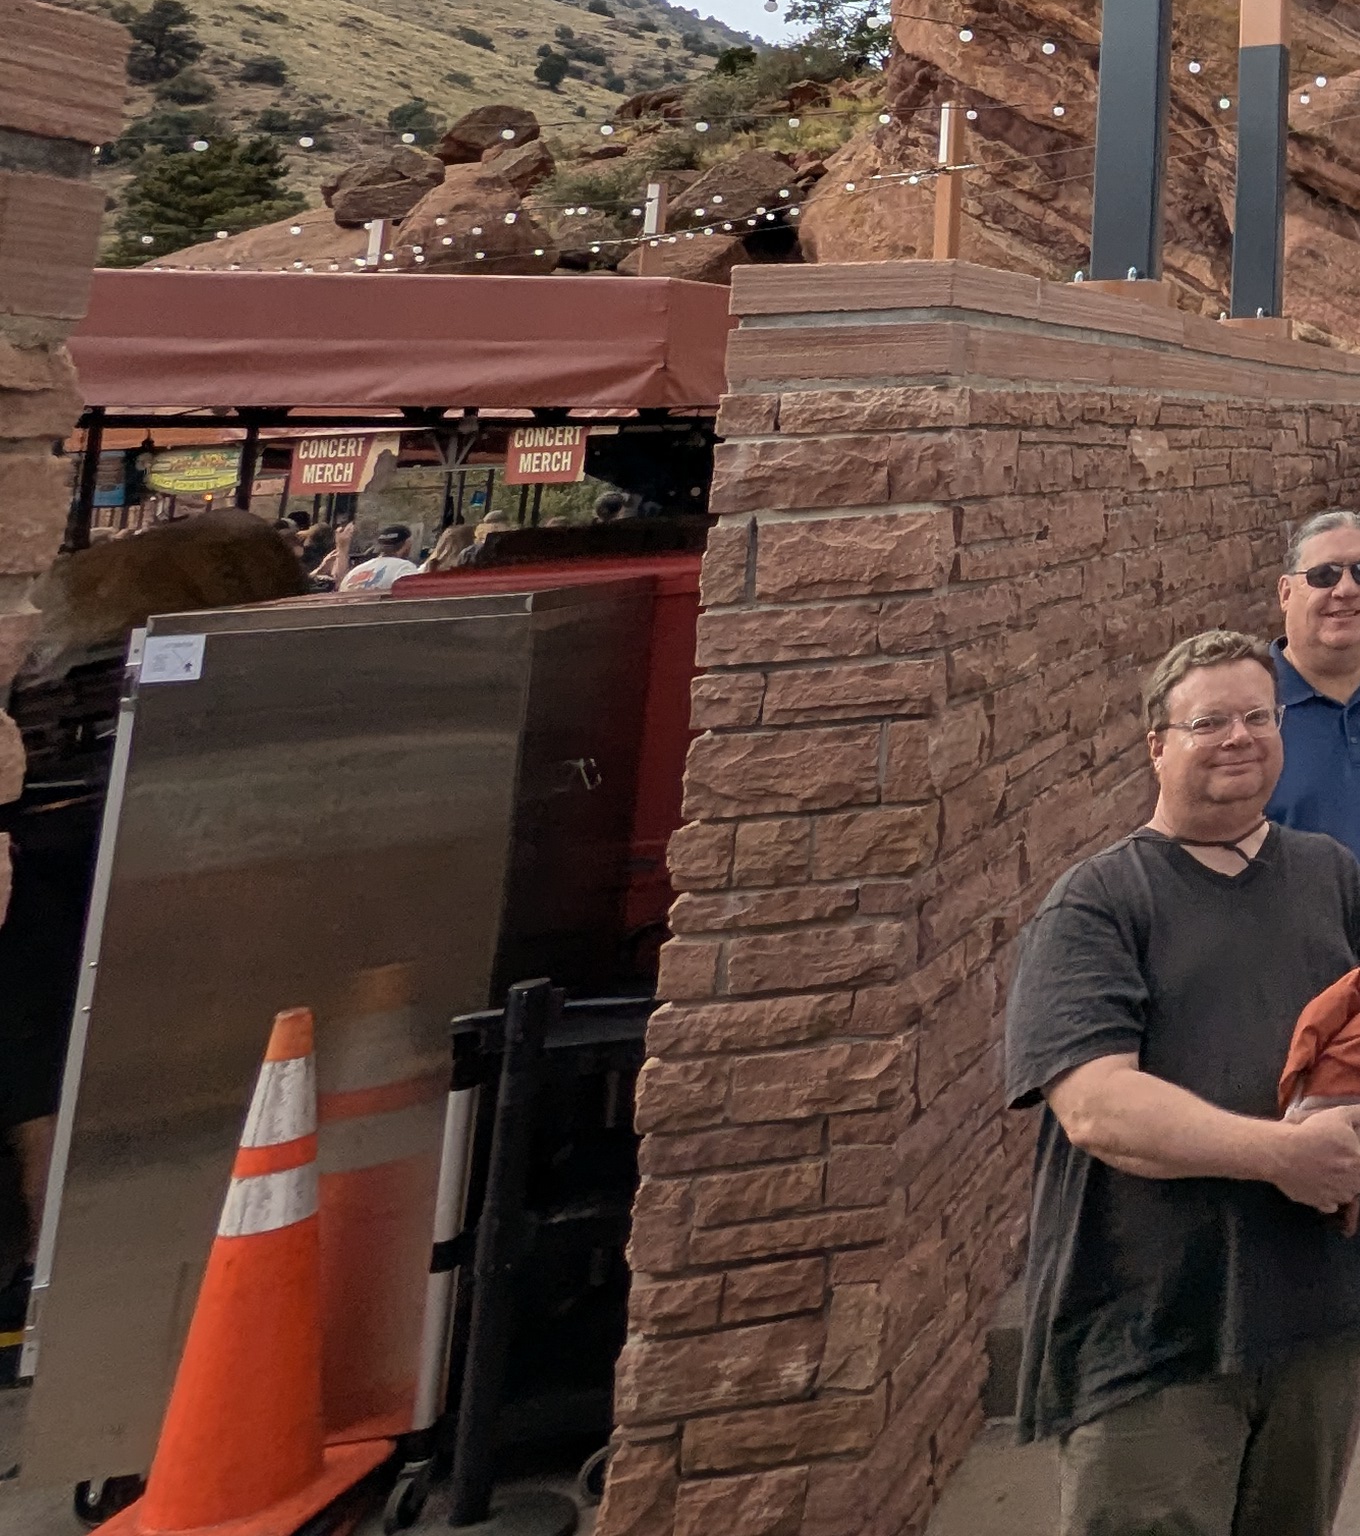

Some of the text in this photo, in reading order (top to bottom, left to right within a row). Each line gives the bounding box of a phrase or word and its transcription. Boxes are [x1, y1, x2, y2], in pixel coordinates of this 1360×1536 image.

[514, 426, 583, 448] CONCERT
[299, 437, 366, 460] CONCERT
[302, 462, 354, 484] MERCH
[519, 451, 572, 473] MERCH
